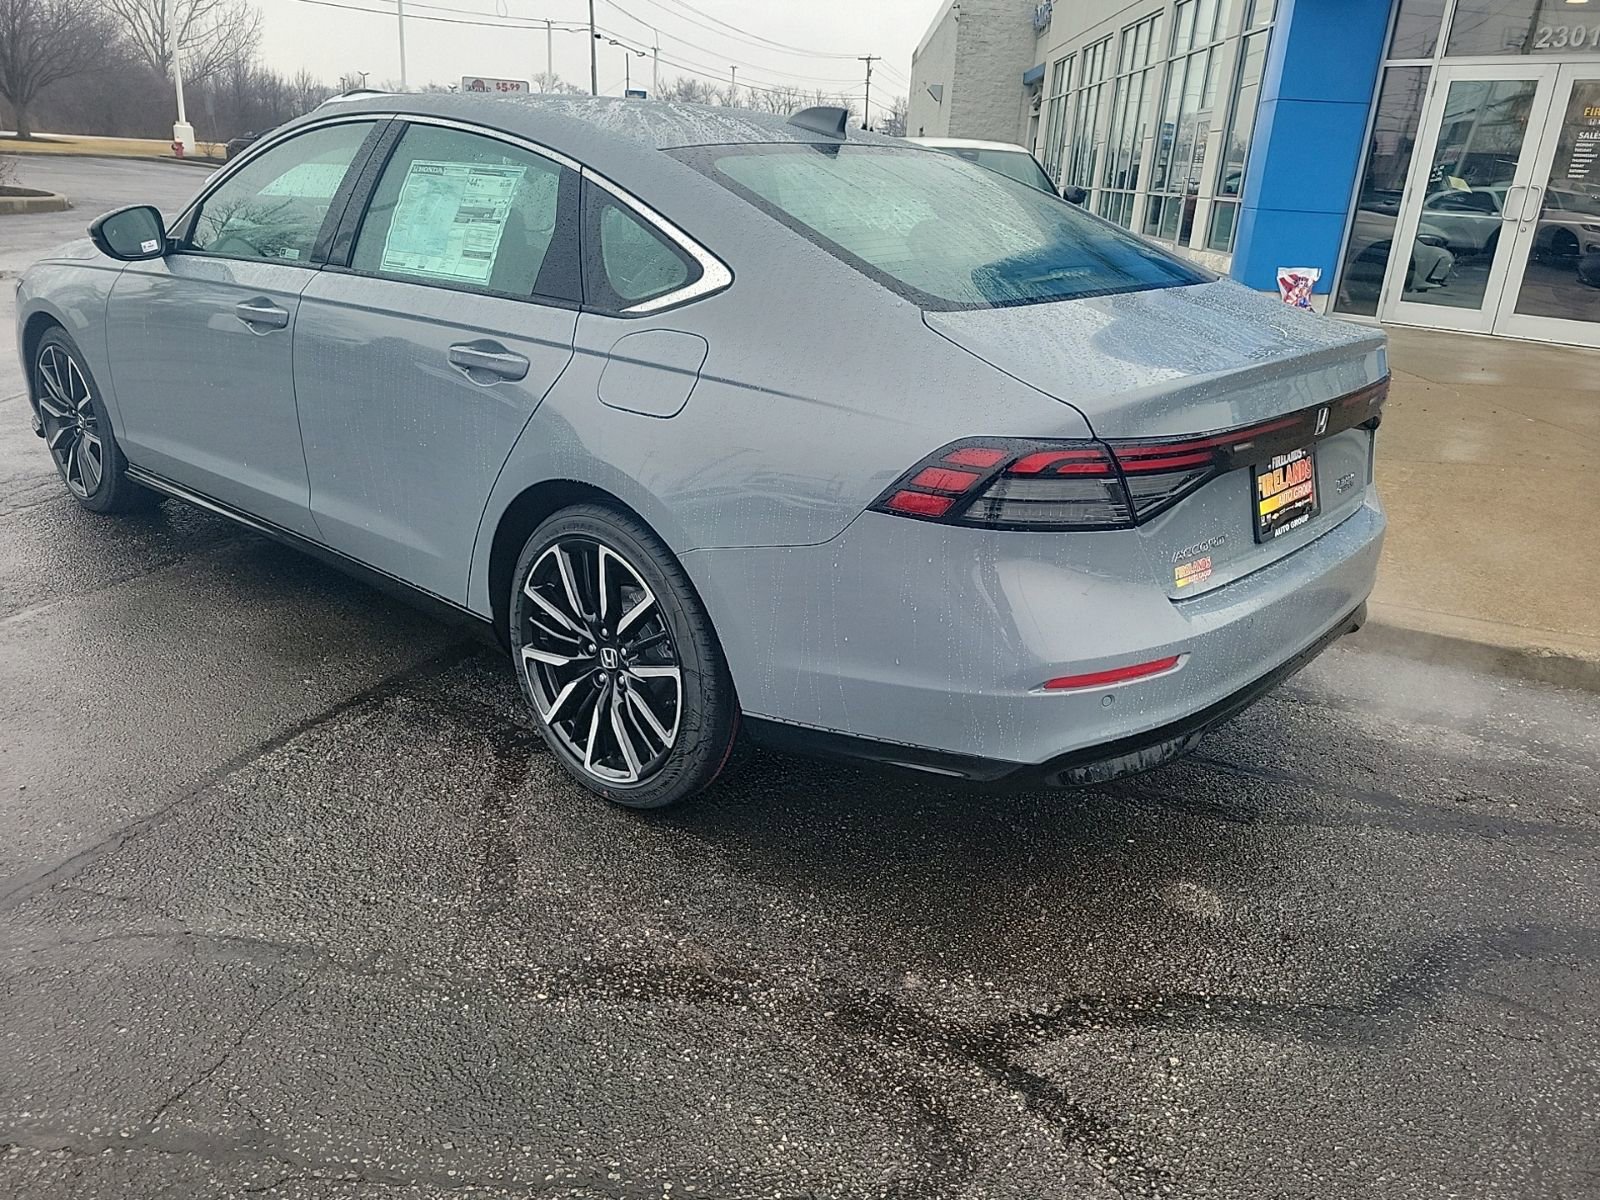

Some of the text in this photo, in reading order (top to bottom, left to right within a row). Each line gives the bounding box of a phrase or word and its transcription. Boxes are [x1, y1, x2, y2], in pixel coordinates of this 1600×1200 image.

[1535, 25, 1600, 48] 2301
[1578, 131, 1600, 140] SALE
[1258, 456, 1312, 500] FIRELANDS
[1274, 513, 1309, 537] AUTO GROUP
